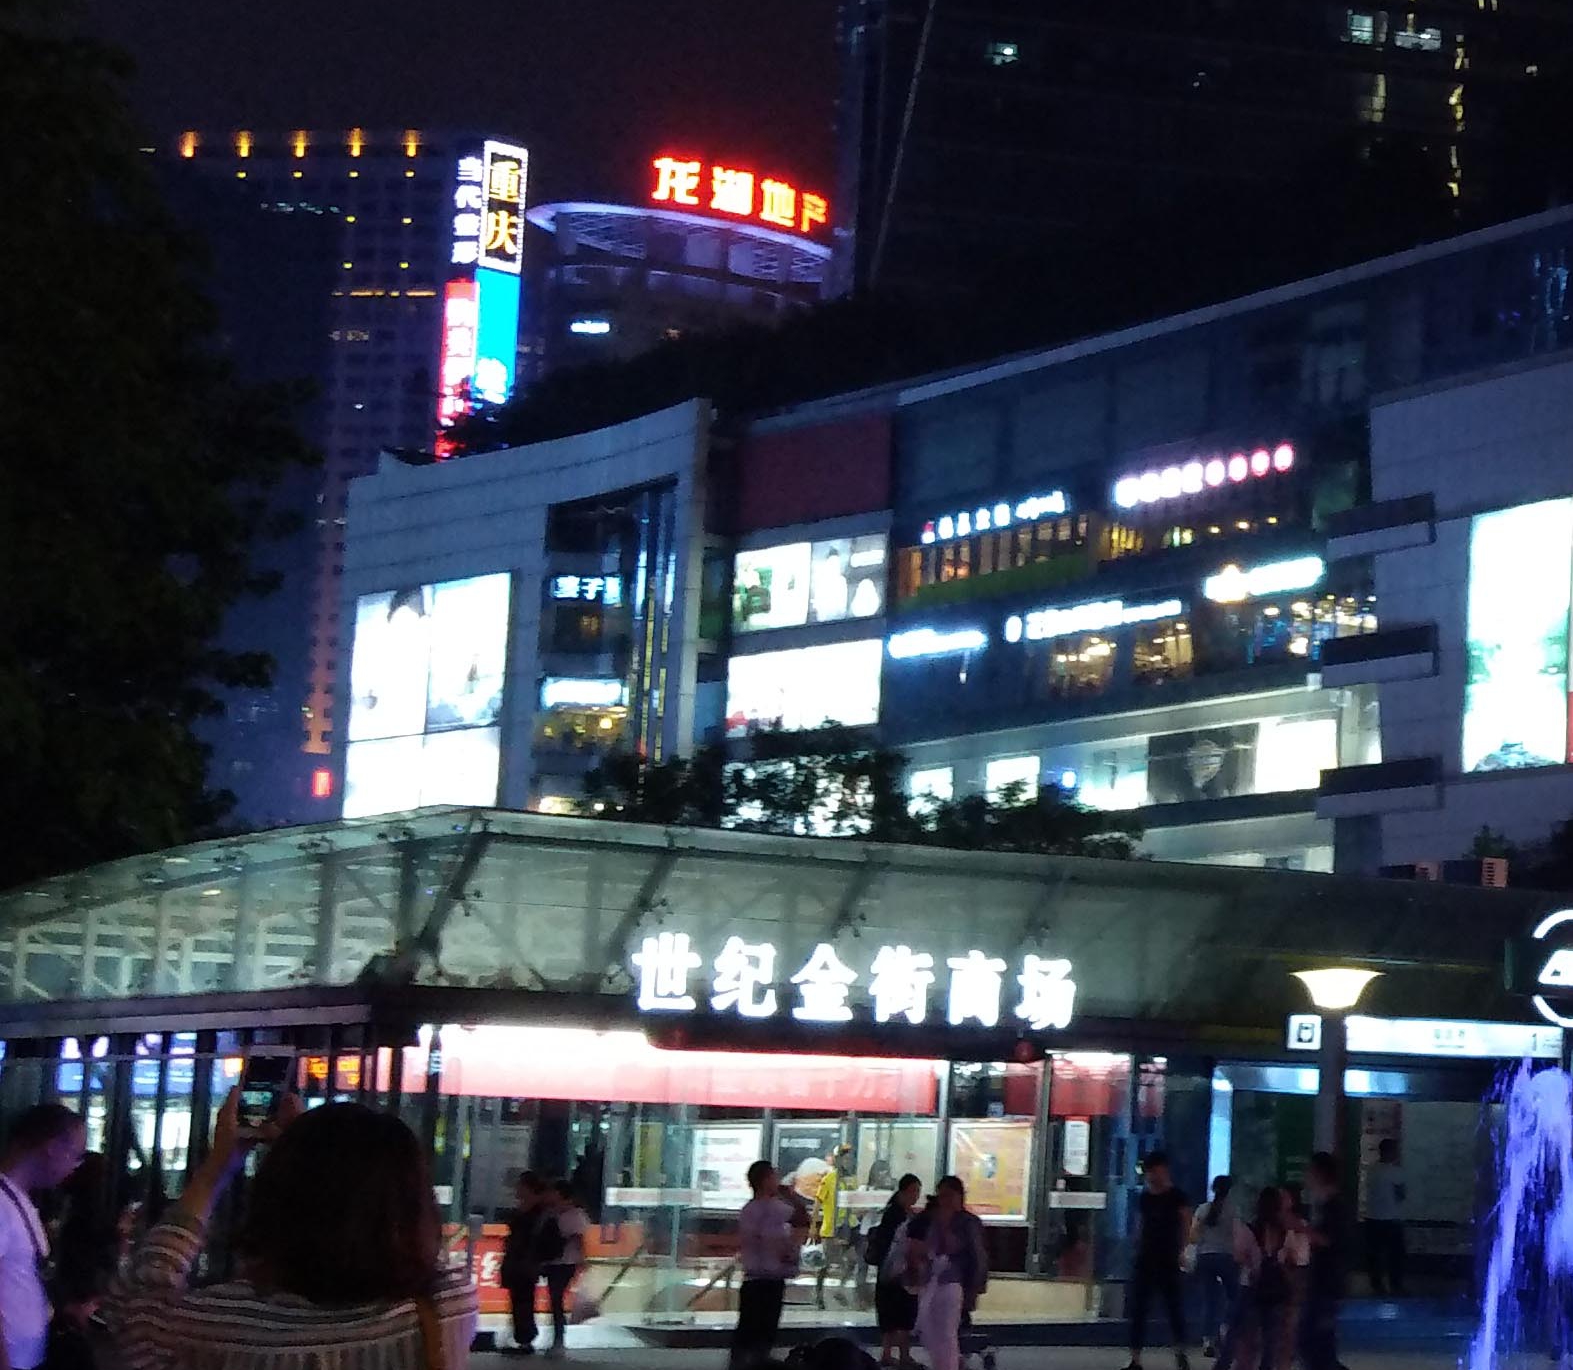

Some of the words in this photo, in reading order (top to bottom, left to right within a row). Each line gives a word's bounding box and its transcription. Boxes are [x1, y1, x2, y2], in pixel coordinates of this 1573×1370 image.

[486, 160, 522, 257] 重庆
[651, 155, 828, 233] 龙湖地产
[632, 931, 1077, 1031] 世纪金街商场
